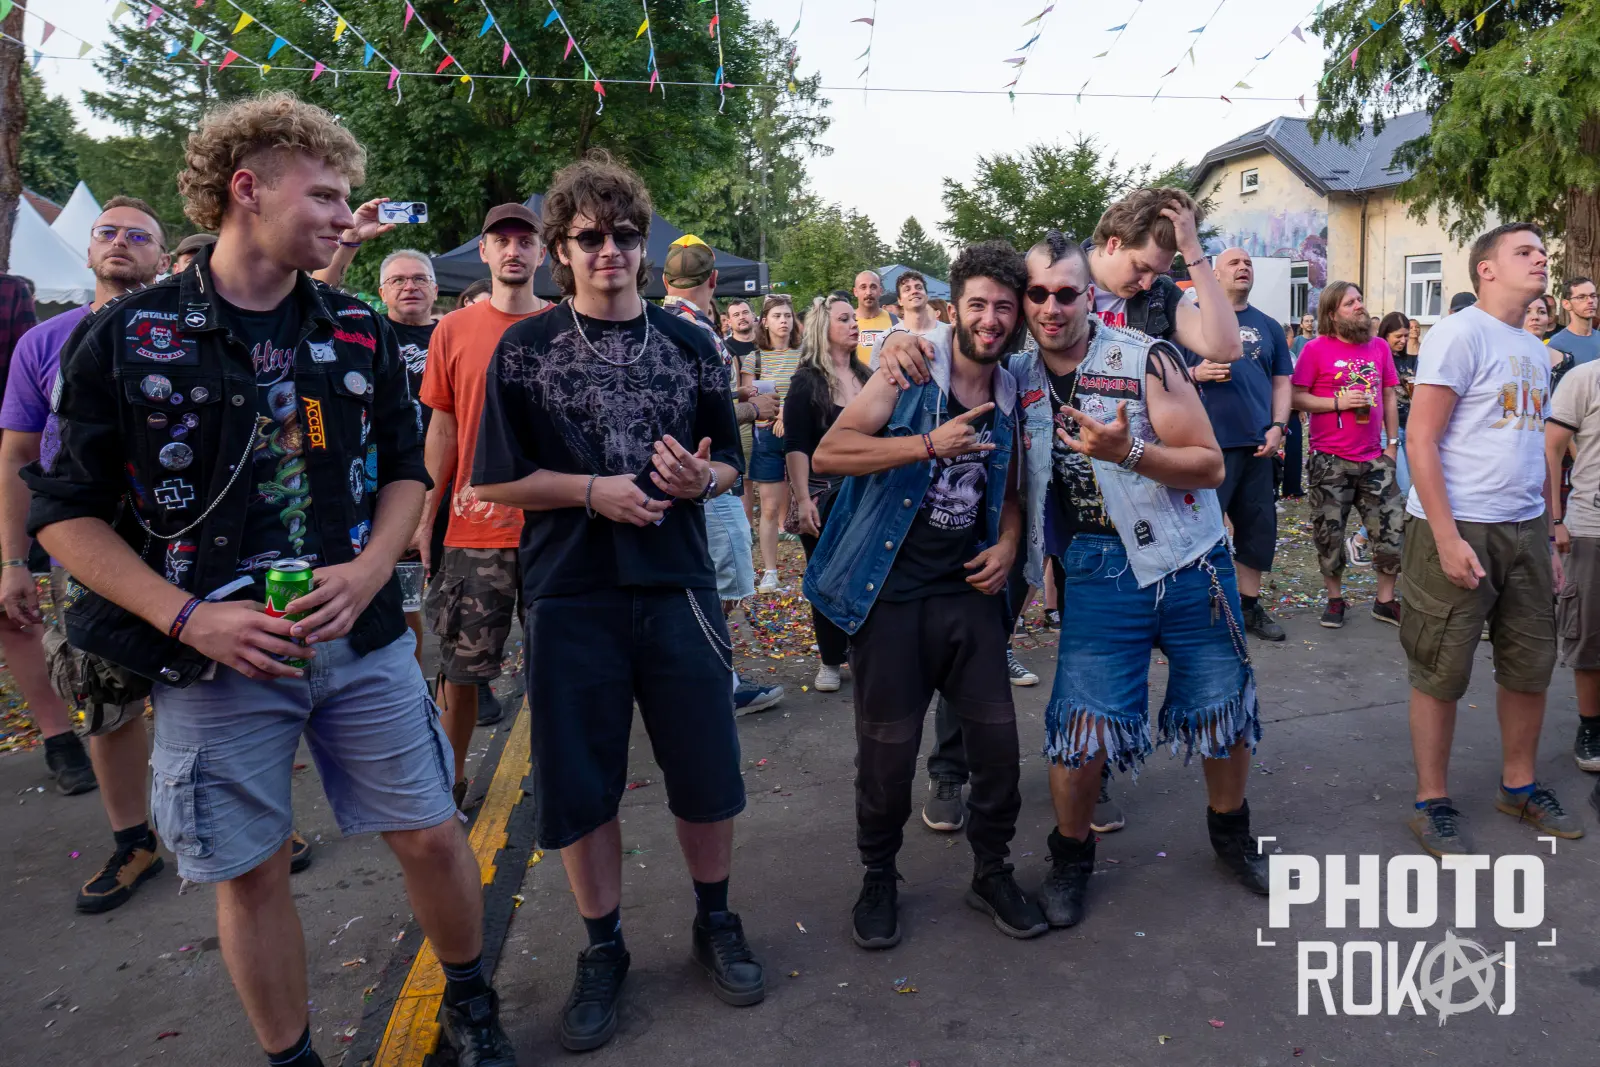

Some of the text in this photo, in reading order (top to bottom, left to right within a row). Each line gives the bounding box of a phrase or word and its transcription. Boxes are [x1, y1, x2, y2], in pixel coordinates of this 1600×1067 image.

[126, 309, 179, 328] METALLIC
[138, 348, 153, 358] KILL
[170, 350, 184, 359] ALL
[1101, 377, 1140, 396] MAIDEN
